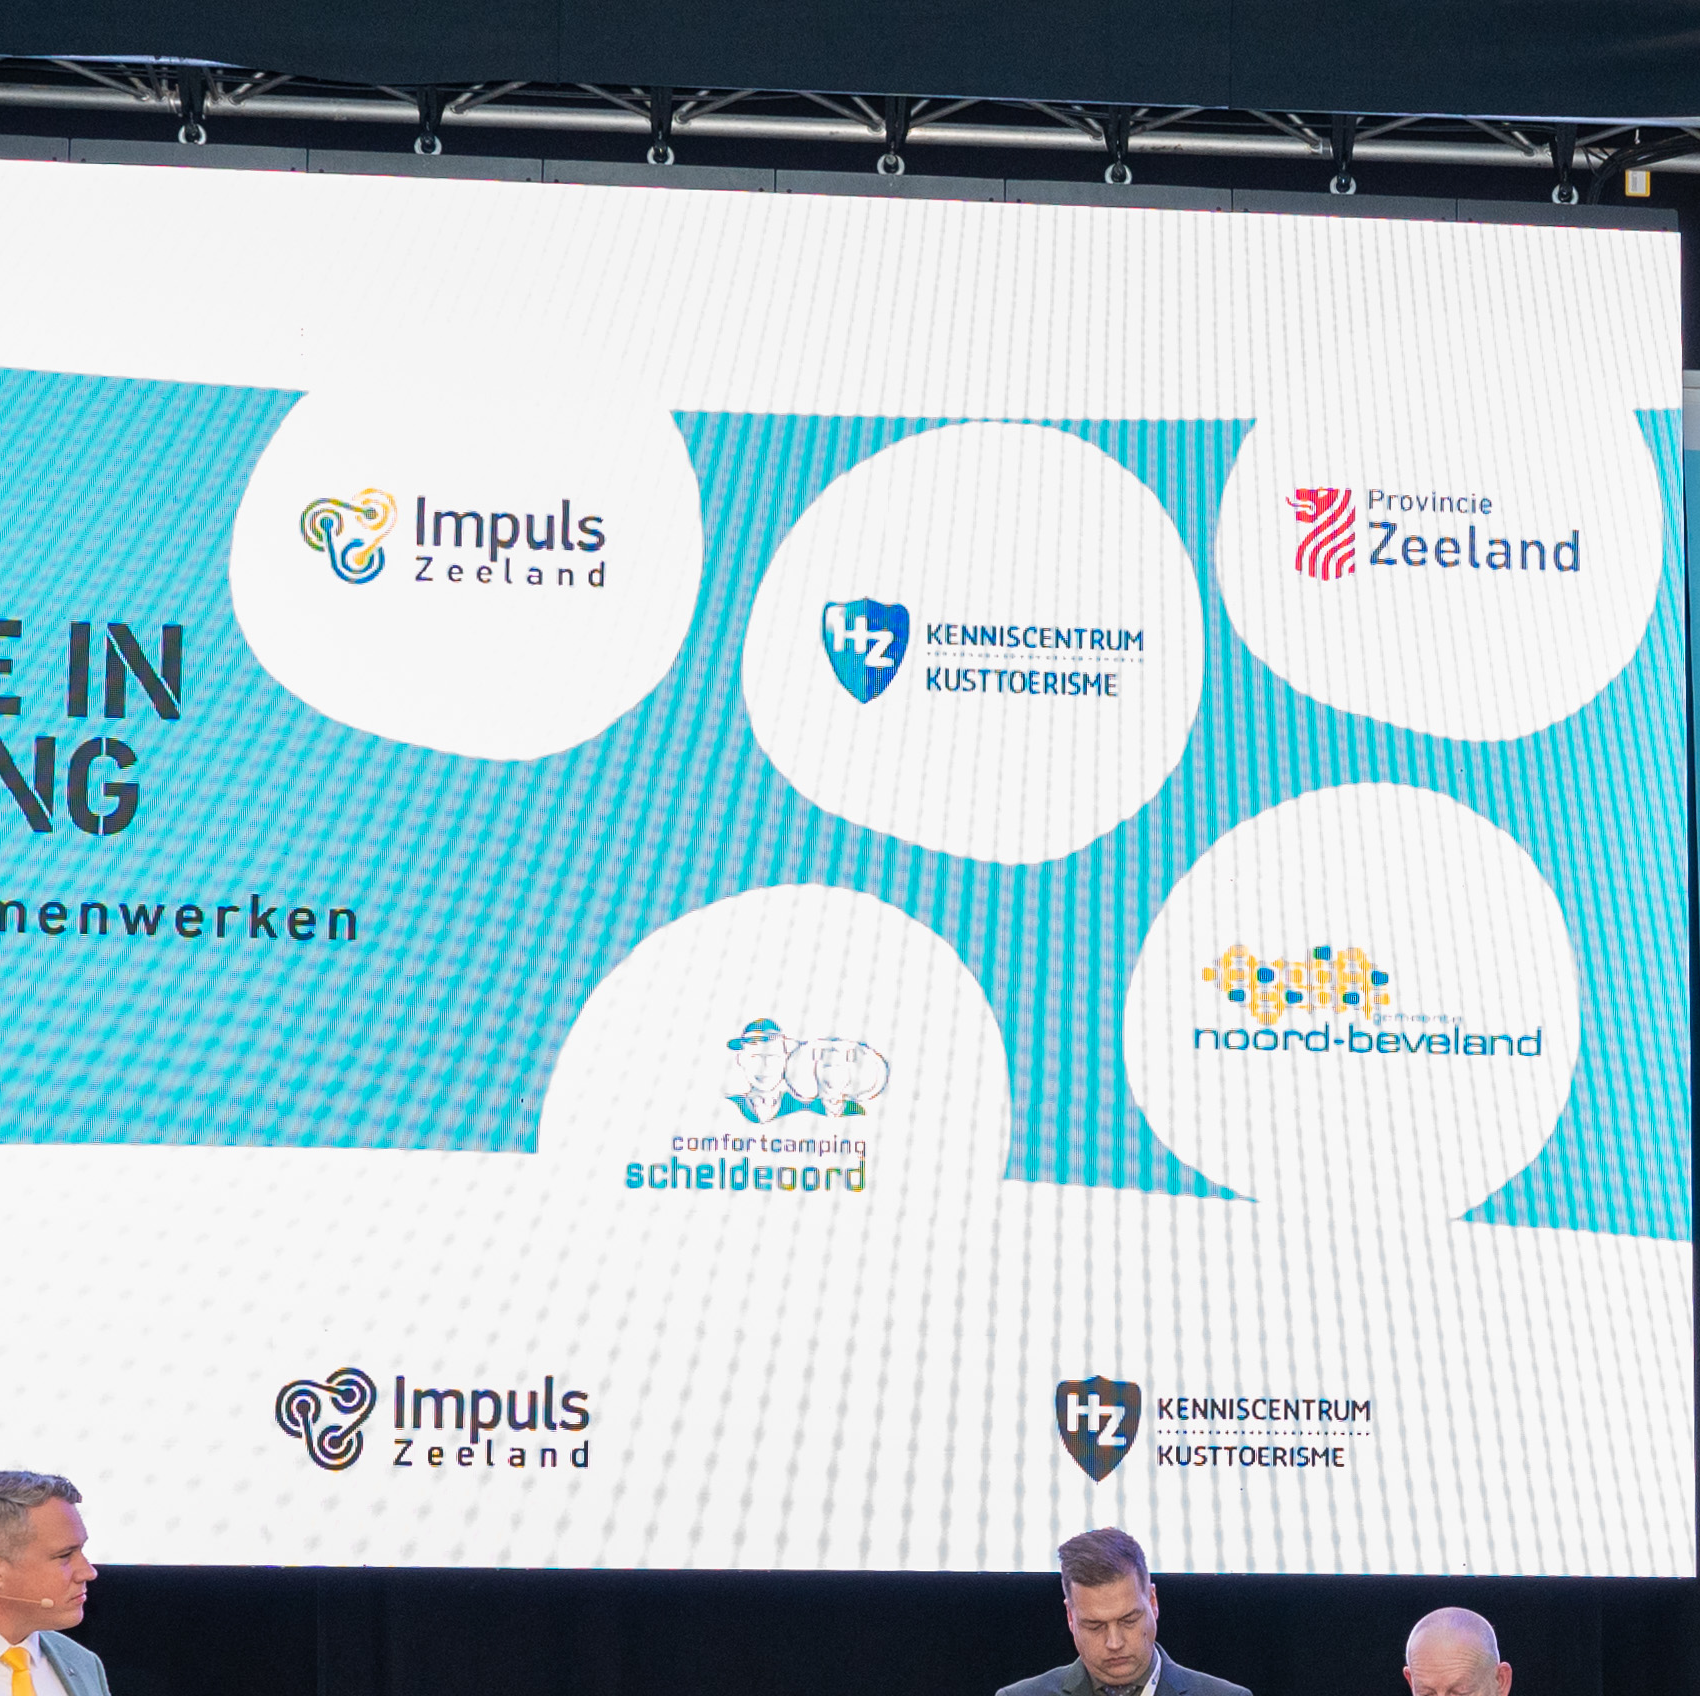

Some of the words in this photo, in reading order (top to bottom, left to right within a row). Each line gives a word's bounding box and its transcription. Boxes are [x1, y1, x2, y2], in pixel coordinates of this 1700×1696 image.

[1368, 488, 1492, 517] Provincie
[414, 496, 608, 561] Impuls
[1367, 524, 1582, 573] Zeeland
[414, 557, 608, 589] Zeeland
[926, 623, 1145, 652] KENNISCENTRUM
[67, 620, 183, 722] IN
[926, 667, 1118, 697] KUSTTOERISME
[1194, 1022, 1542, 1057] noord-beveland
[672, 1134, 866, 1157] comfortcamping
[624, 1156, 866, 1192] scheldeoord
[393, 1376, 591, 1436] Impuls
[1157, 1398, 1372, 1423] KENNISCENTRUM
[394, 1440, 591, 1469] Zeeland
[1158, 1445, 1346, 1468] KUSTTOERISME
